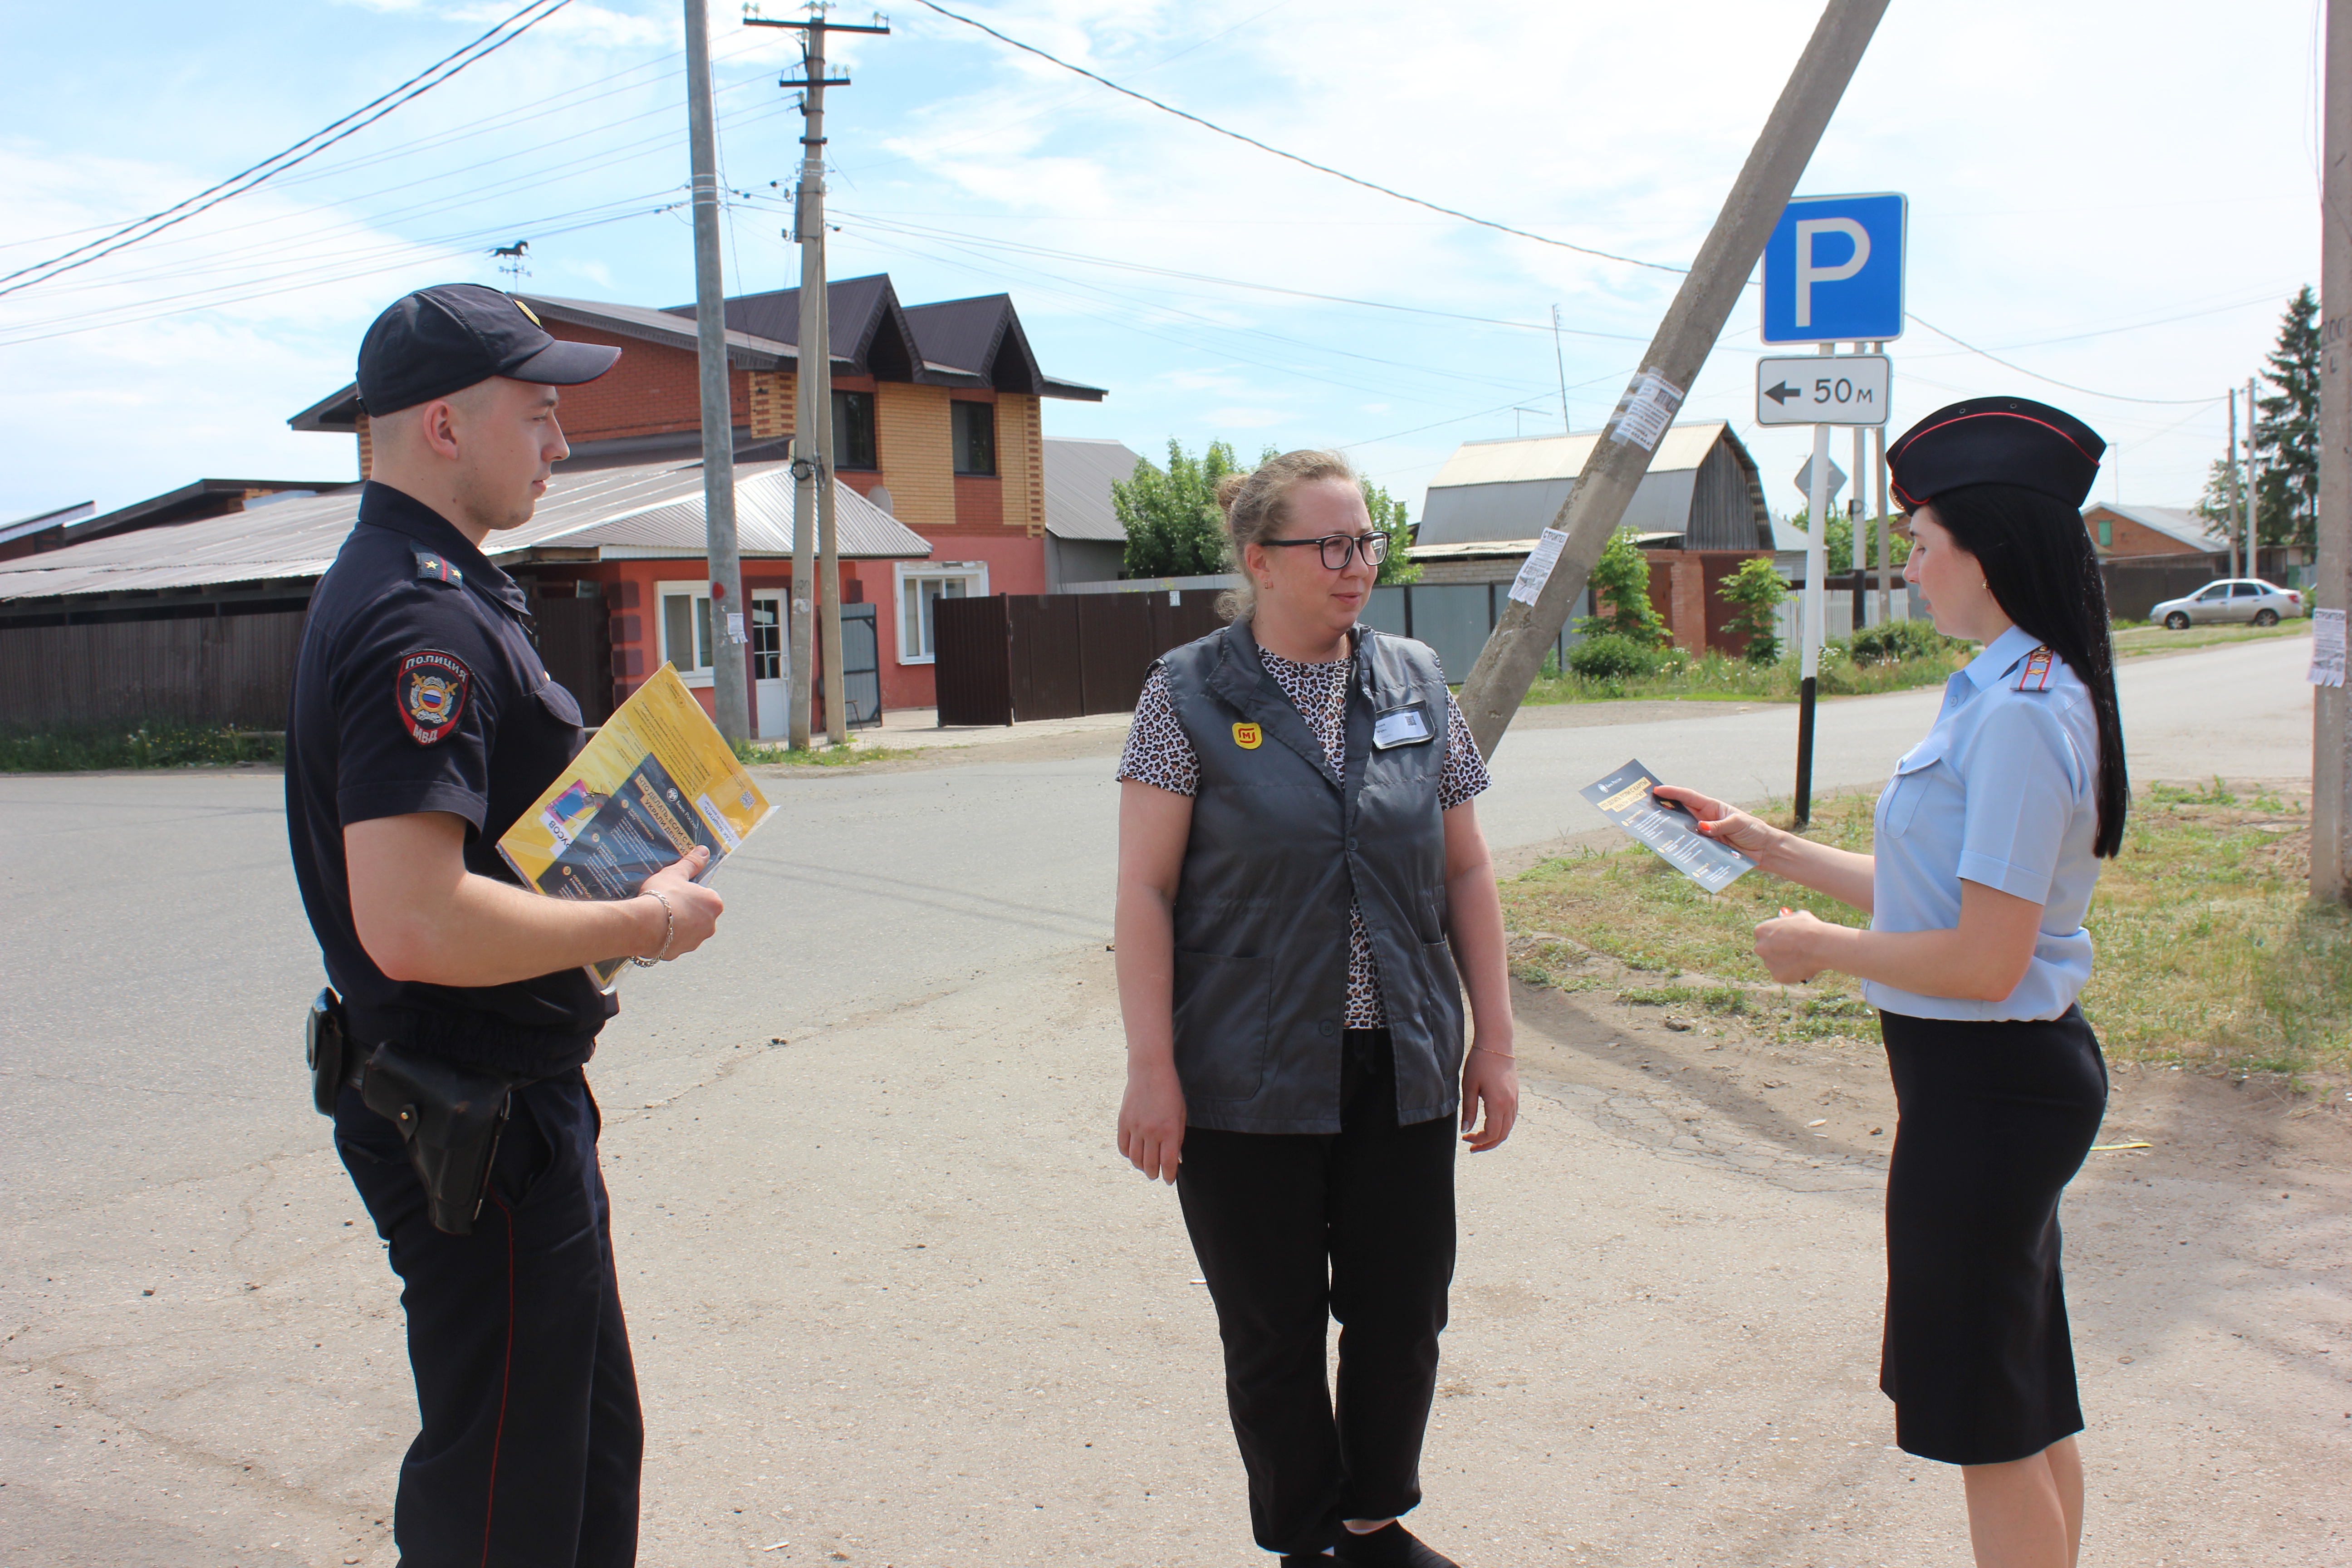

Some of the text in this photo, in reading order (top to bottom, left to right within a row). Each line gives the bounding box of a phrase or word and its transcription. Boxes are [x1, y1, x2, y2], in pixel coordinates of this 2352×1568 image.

[405, 656, 468, 682] ПОЛИЦИЯ
[413, 724, 438, 743] МВД
[636, 776, 650, 792] ЧТО
[647, 791, 671, 820] ДЕЛАТЬ,
[668, 818, 684, 837] ЕСЛИ
[686, 841, 695, 851] КА
[643, 799, 666, 827] УКРАЛИ
[675, 799, 687, 813] Банк
[703, 805, 732, 843] КАК ЗАЩИТИТЬ
